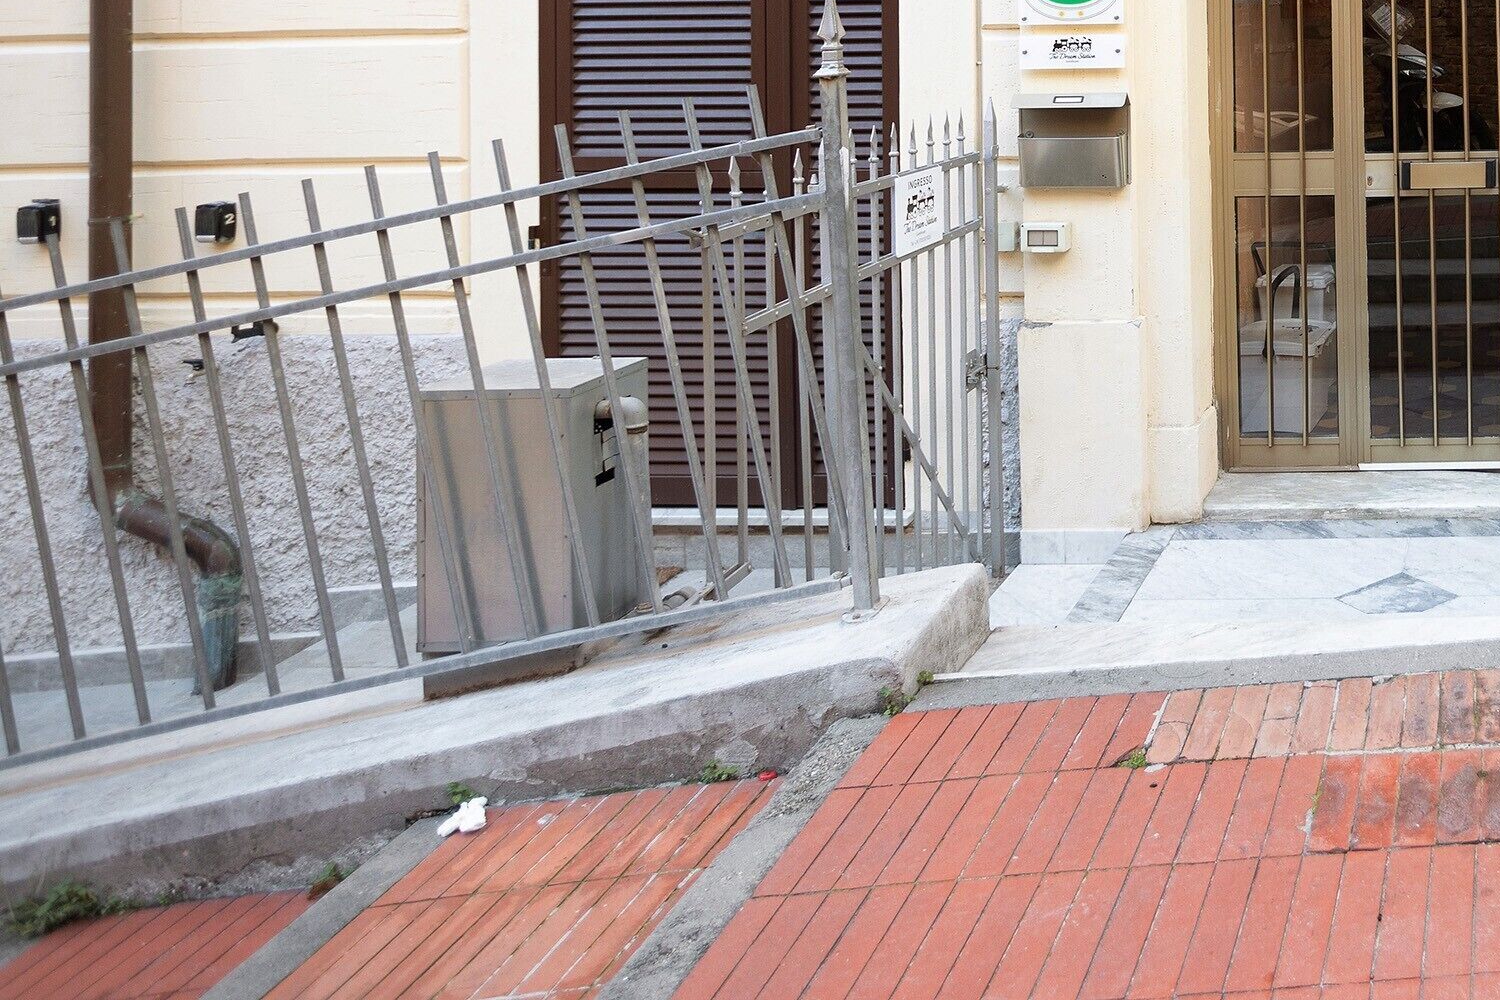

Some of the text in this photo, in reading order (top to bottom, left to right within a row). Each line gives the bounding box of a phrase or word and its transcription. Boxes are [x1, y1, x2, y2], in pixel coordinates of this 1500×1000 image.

[908, 174, 933, 189] INGRESSO
[49, 215, 57, 227] 1
[224, 213, 235, 226] 2
